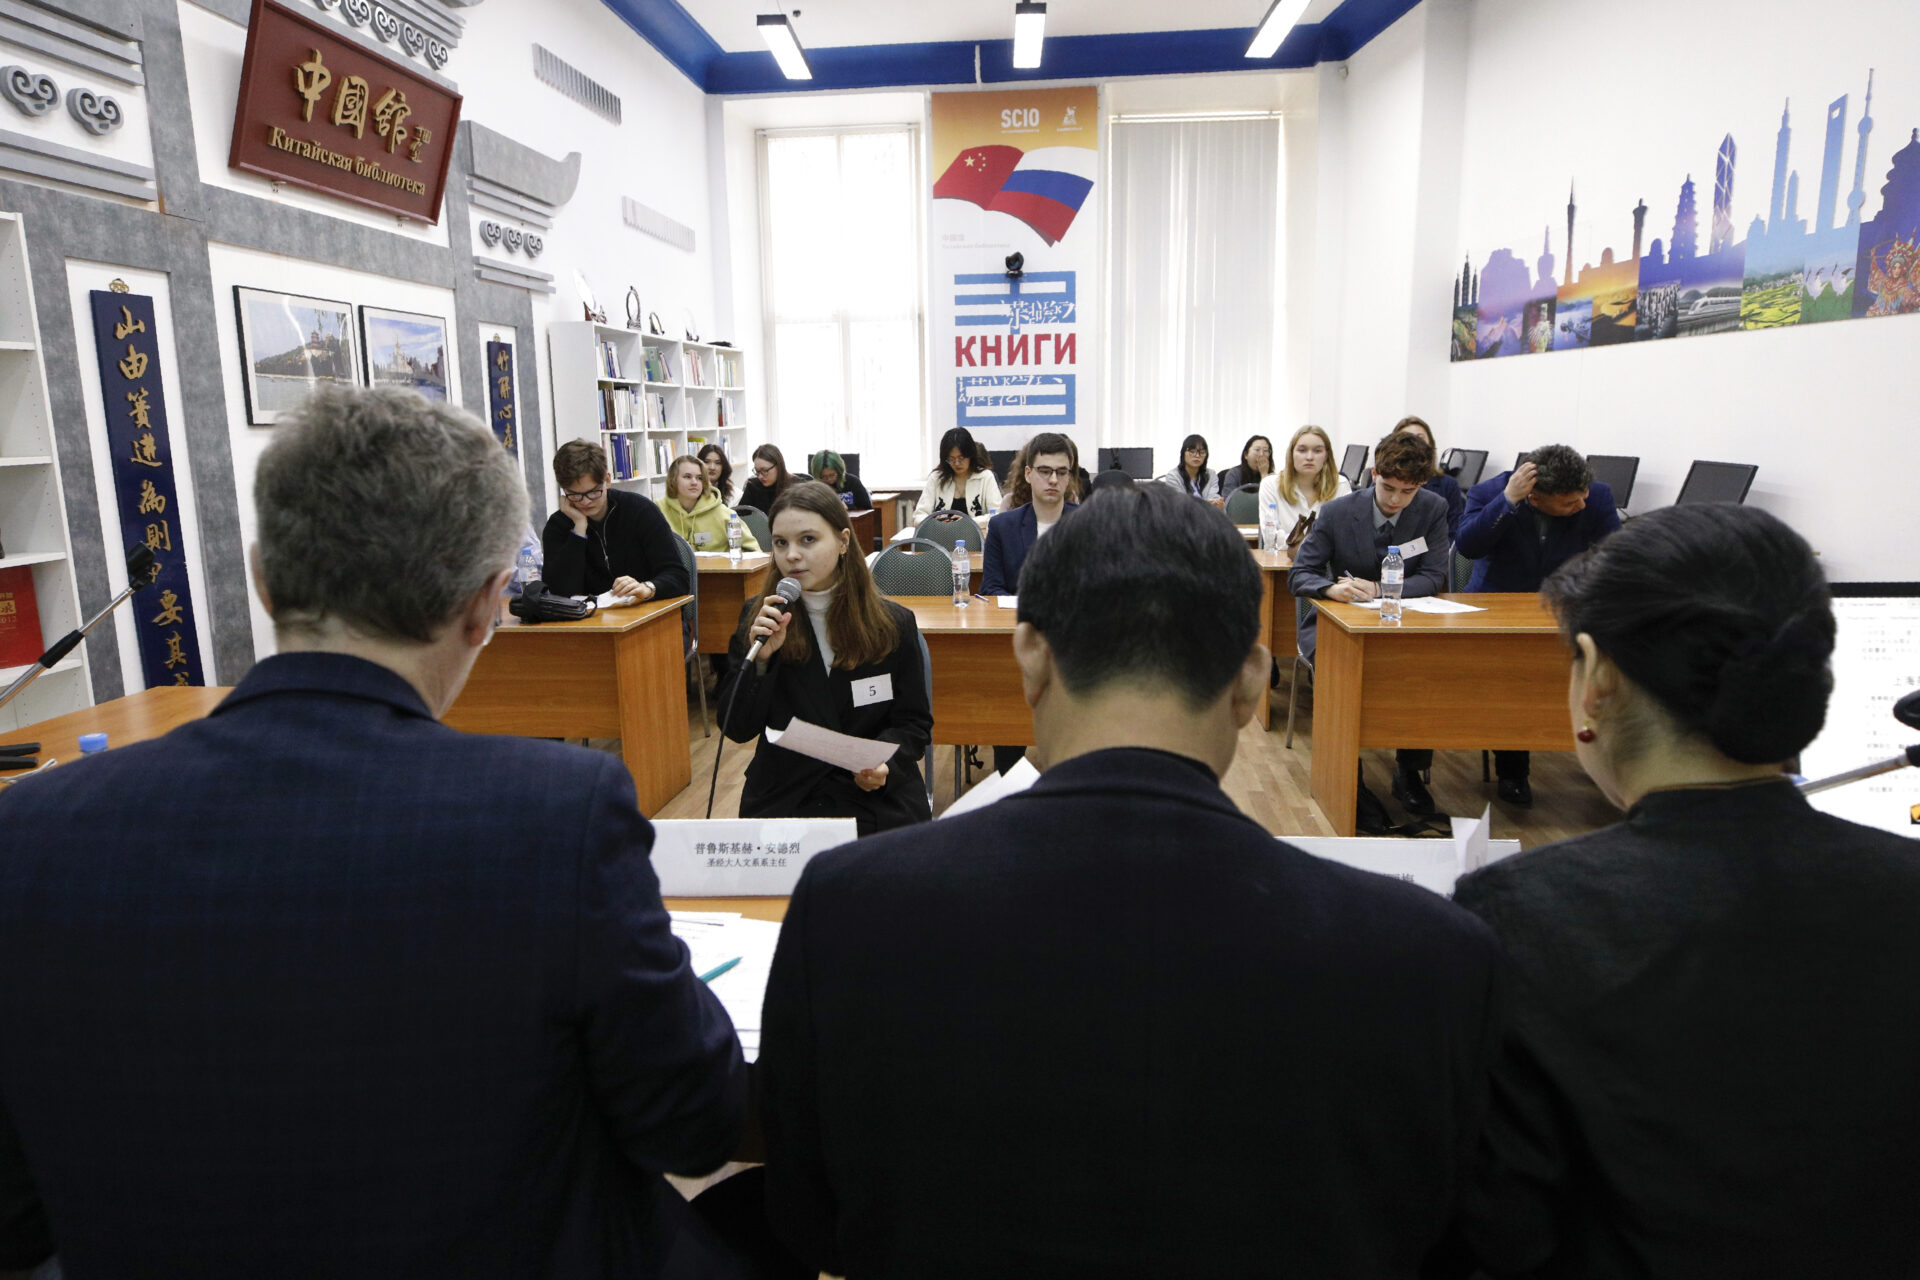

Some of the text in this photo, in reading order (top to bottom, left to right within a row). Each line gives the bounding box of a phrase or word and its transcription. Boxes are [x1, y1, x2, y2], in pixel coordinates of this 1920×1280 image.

[1001, 108, 1040, 128] SCIO
[269, 125, 426, 196] Китайская библиотека
[955, 333, 1076, 367] КНИГИ
[869, 685, 876, 697] 5
